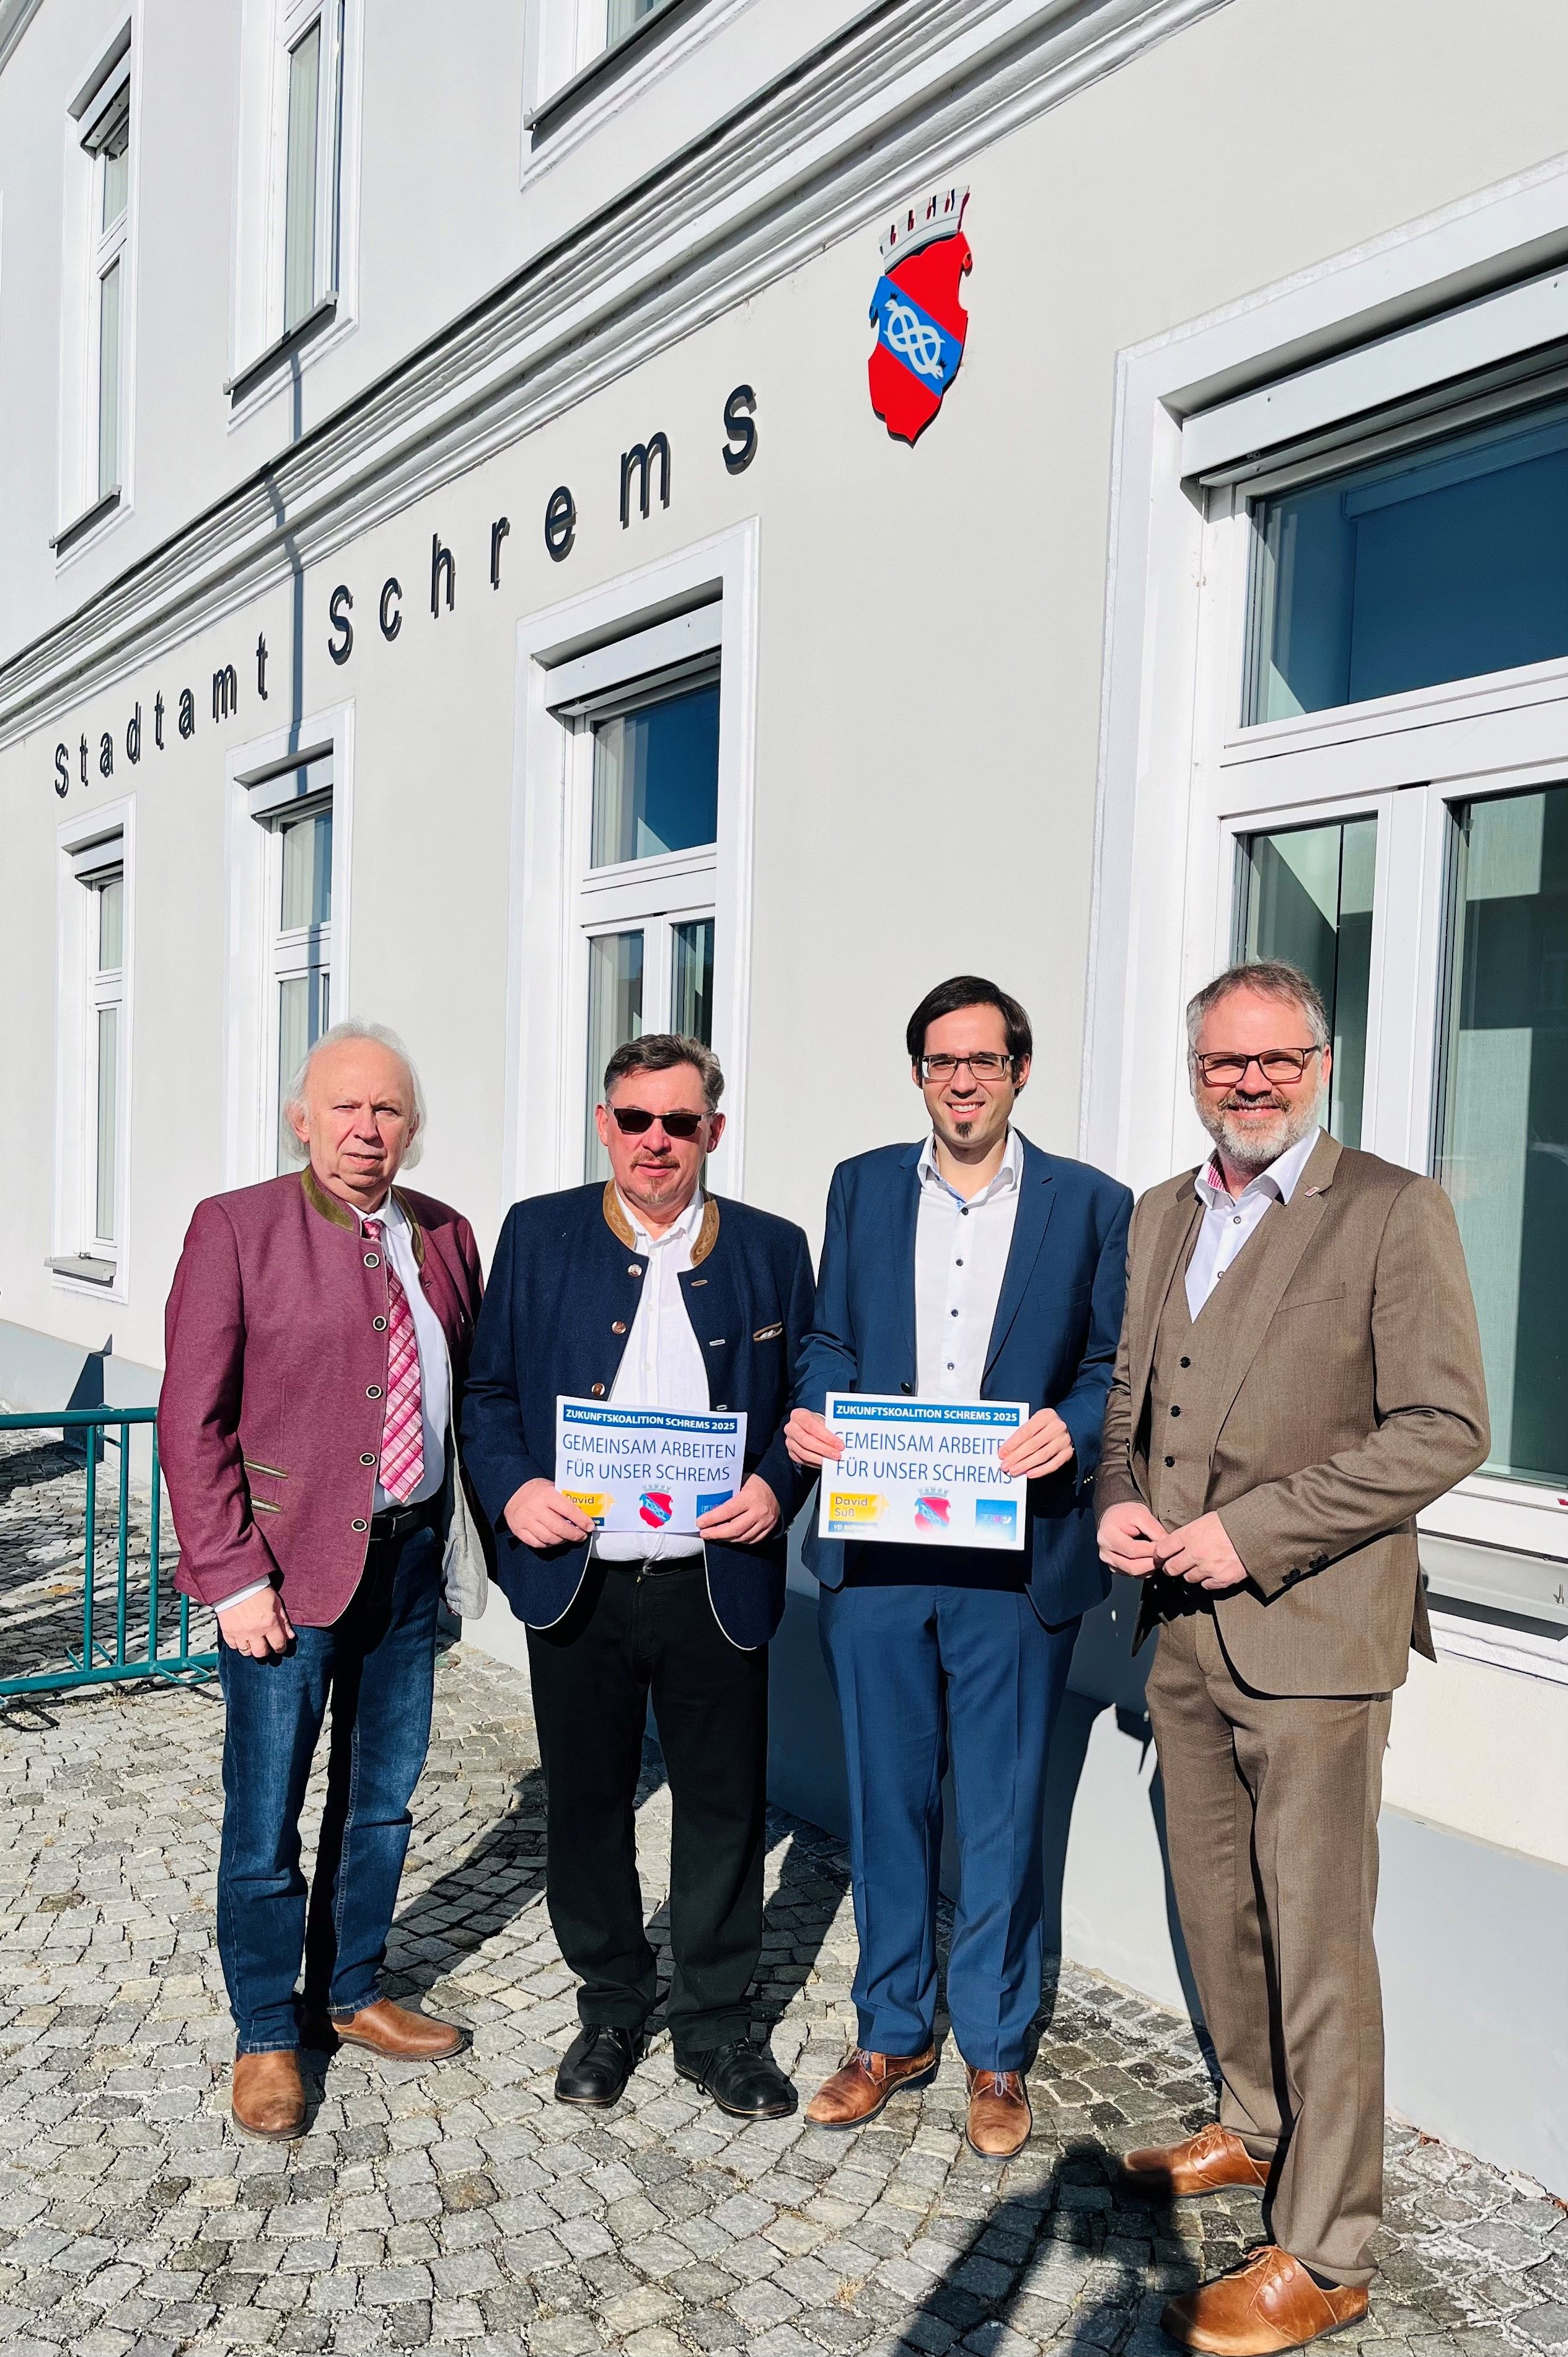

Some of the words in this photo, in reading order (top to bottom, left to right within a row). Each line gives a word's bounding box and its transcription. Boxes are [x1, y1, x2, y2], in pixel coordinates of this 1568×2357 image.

[54, 631, 268, 798] Stadtamt
[328, 384, 757, 665] Schrems
[565, 1409, 664, 1425] ZUKUNFTSKOALITION
[665, 1419, 710, 1430] SCHREMS
[711, 1421, 735, 1430] 2025
[836, 1405, 941, 1419] ZUKUNFTSKOALITION
[943, 1411, 991, 1421] SCHREMS
[993, 1412, 1017, 1422] 2025
[563, 1434, 656, 1454] GEMEINSAM
[661, 1440, 736, 1458] ARBEITEN
[566, 1458, 594, 1478] FÜR
[599, 1463, 651, 1479] UNSER
[656, 1465, 729, 1482] SCHREMS
[837, 1456, 868, 1478] FÜR
[874, 1461, 928, 1481] UNSER
[933, 1464, 1012, 1484] SCHREMS
[835, 1496, 868, 1506] David
